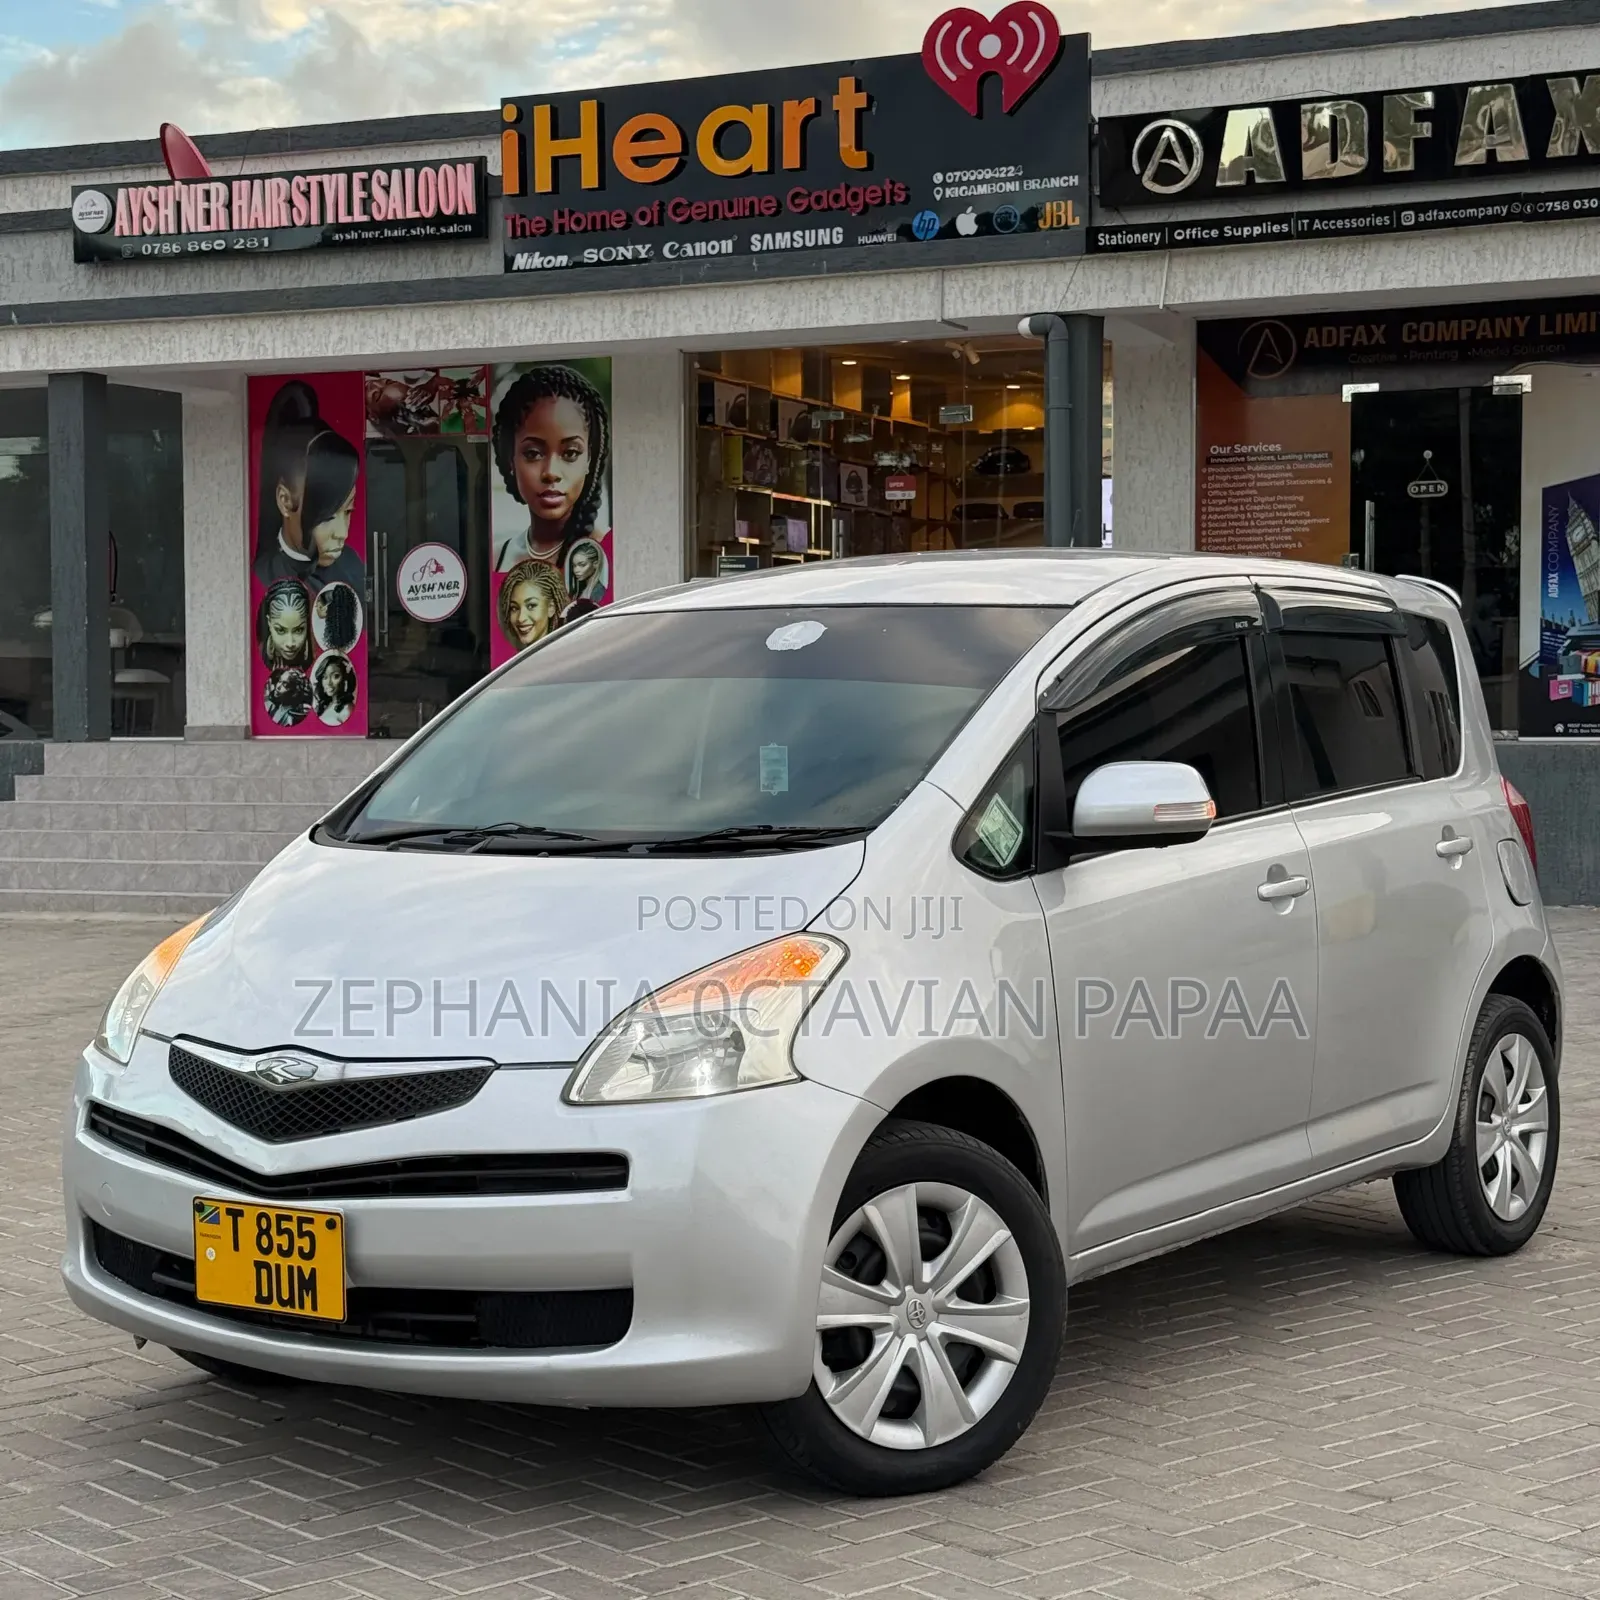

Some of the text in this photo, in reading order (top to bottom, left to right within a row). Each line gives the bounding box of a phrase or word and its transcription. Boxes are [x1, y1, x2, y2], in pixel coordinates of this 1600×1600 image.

[502, 77, 867, 195] iHeart
[1215, 74, 1600, 187] ADFAX
[114, 181, 229, 237] AYSH'NER
[371, 163, 476, 221] SALOON
[504, 178, 908, 238] The Home of Genuine Gadgets
[945, 175, 1079, 198] KIGAMBONI BRANCH
[1417, 204, 1509, 222] adfaxcompany
[142, 236, 270, 257] 0786 860 281
[512, 253, 568, 271] Nikon
[583, 243, 651, 263] SONY
[662, 238, 734, 259] Canon
[750, 226, 844, 252] SAMSUNG
[858, 233, 897, 245] HUAWEI
[1038, 199, 1080, 230] JBL
[1098, 213, 1390, 246] Stationery Office Supplies IT Accessories
[1304, 323, 1387, 348] ADFAX
[1402, 315, 1531, 343] COMPANY
[1209, 442, 1282, 454] Our Services
[1410, 484, 1445, 493] OPEN
[1547, 504, 1560, 571] COMPANY
[225, 1207, 317, 1261] T 855
[253, 1259, 318, 1312] DUM
